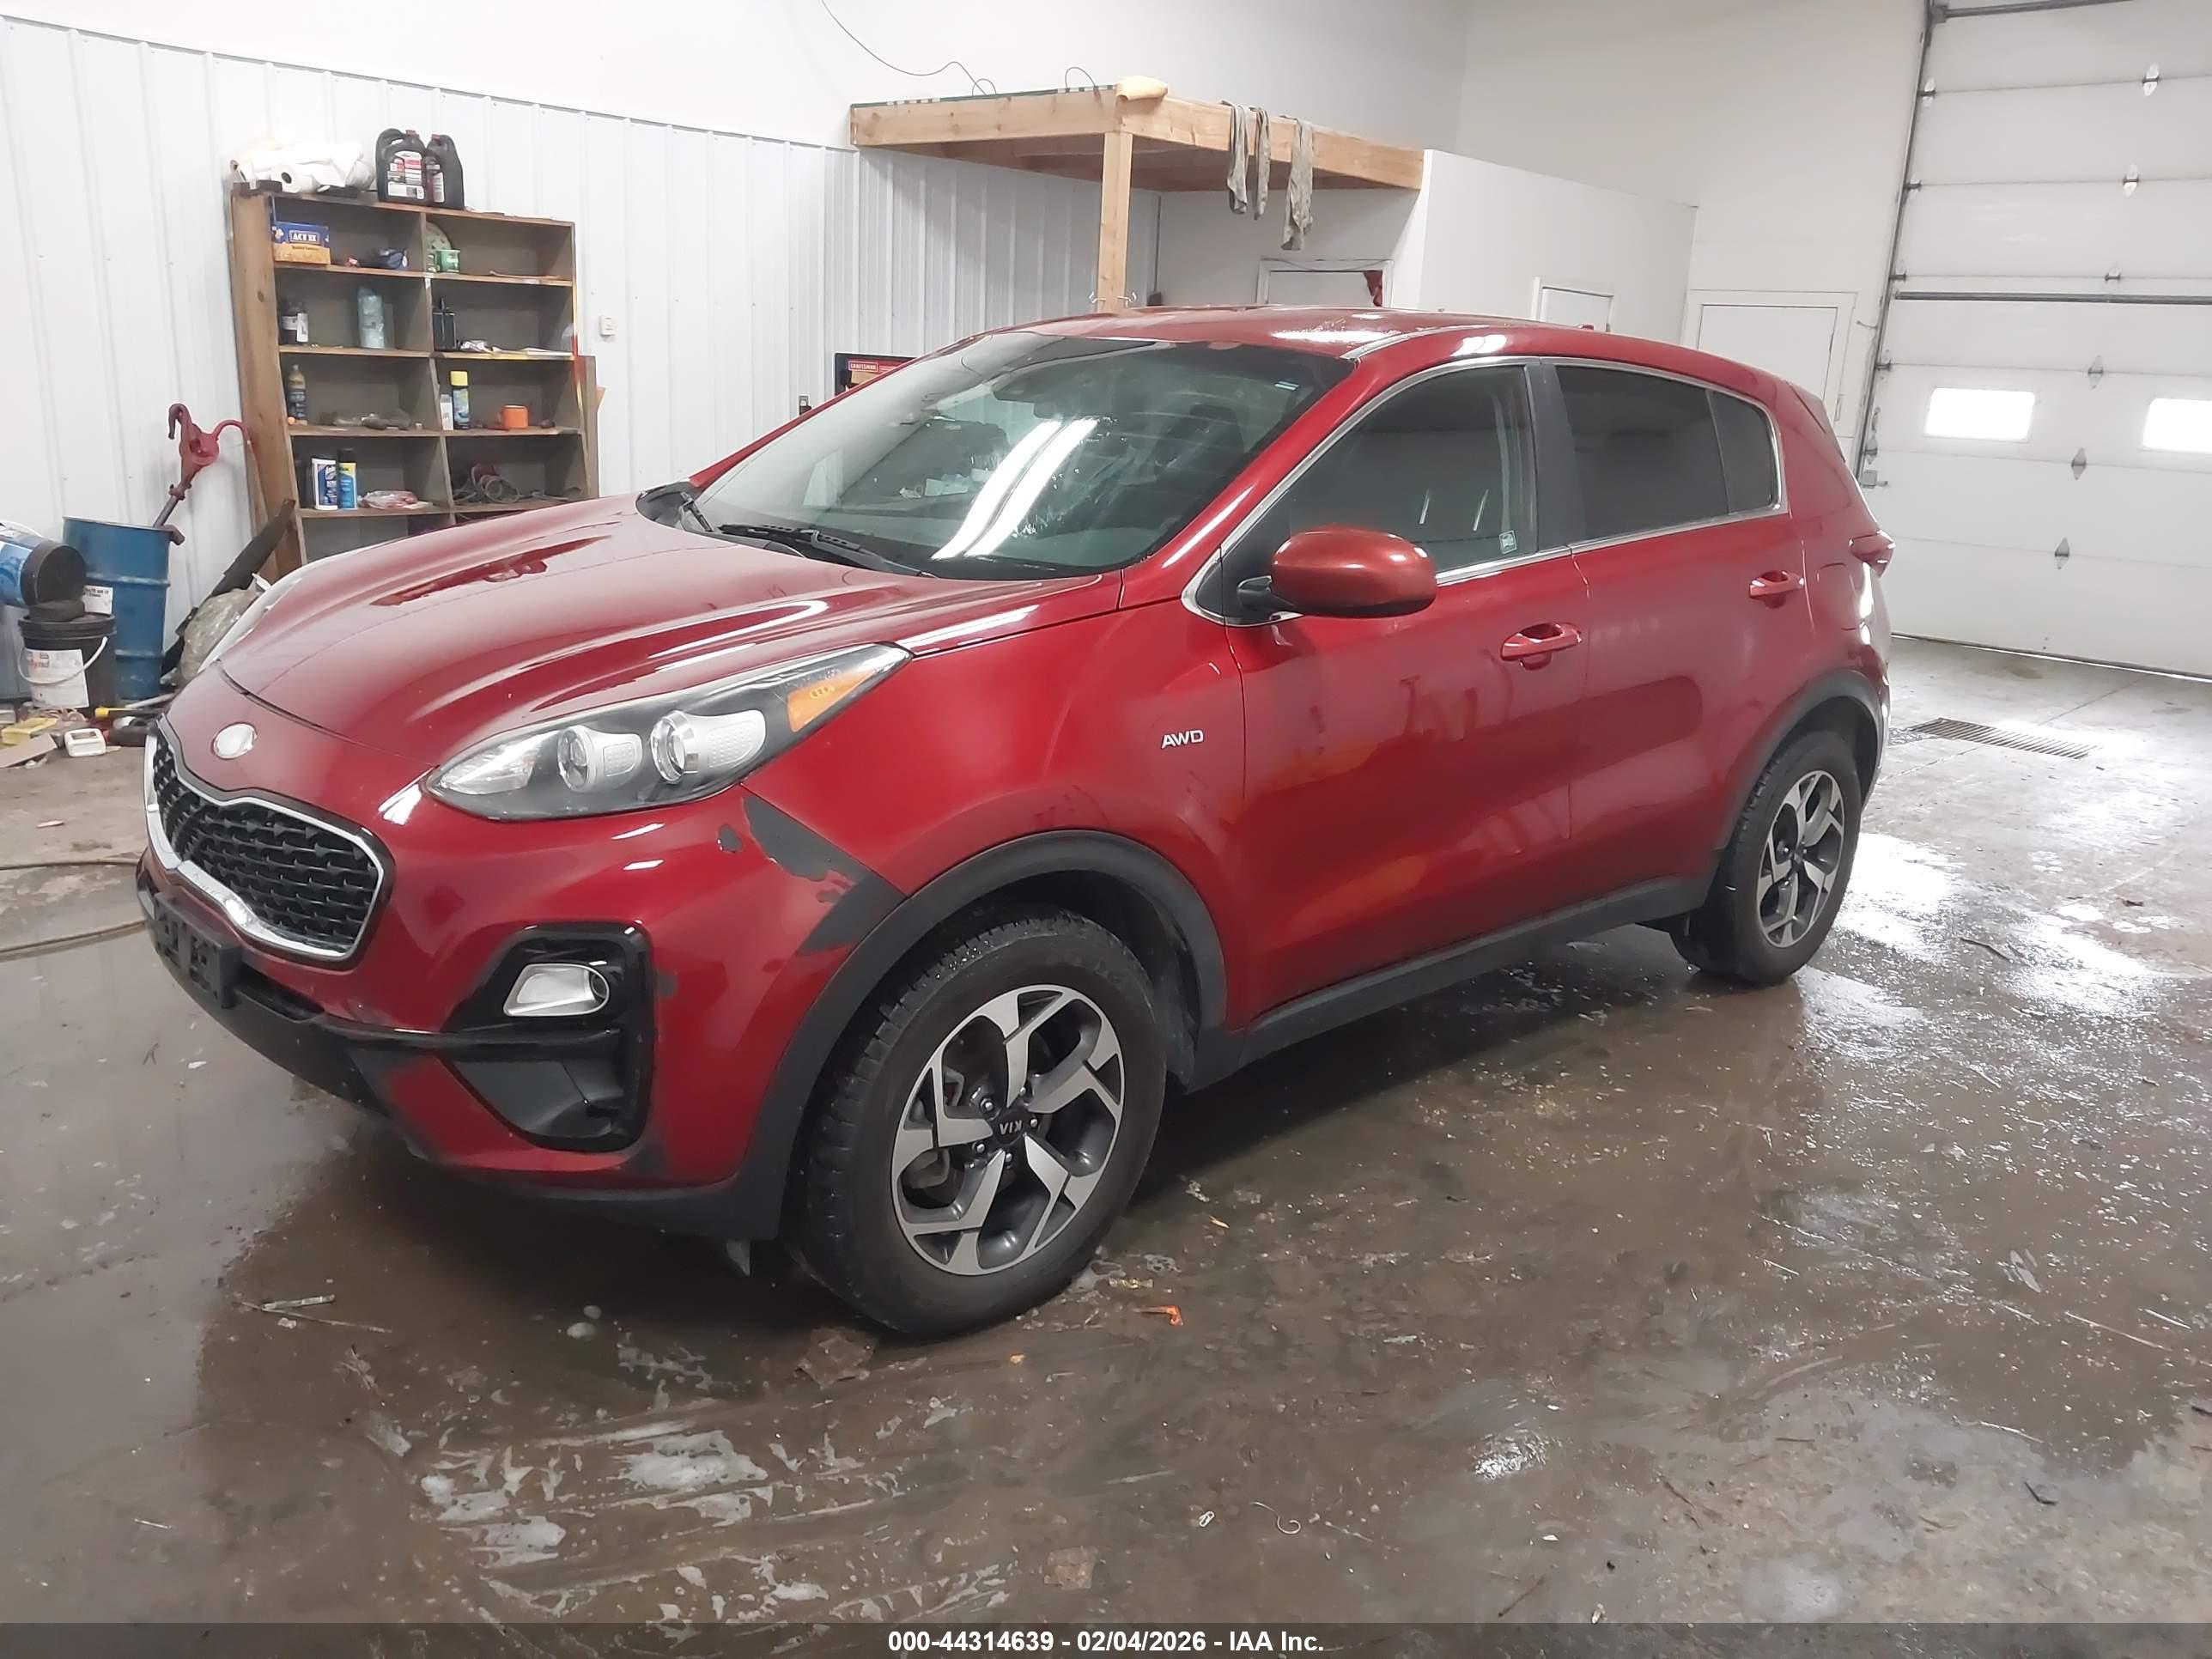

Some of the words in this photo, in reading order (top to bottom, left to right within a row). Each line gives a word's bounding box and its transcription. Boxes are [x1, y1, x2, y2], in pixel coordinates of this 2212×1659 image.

[293, 233, 307, 241] ACT
[1161, 729, 1204, 749] AWD
[999, 1119, 1023, 1135] KIA
